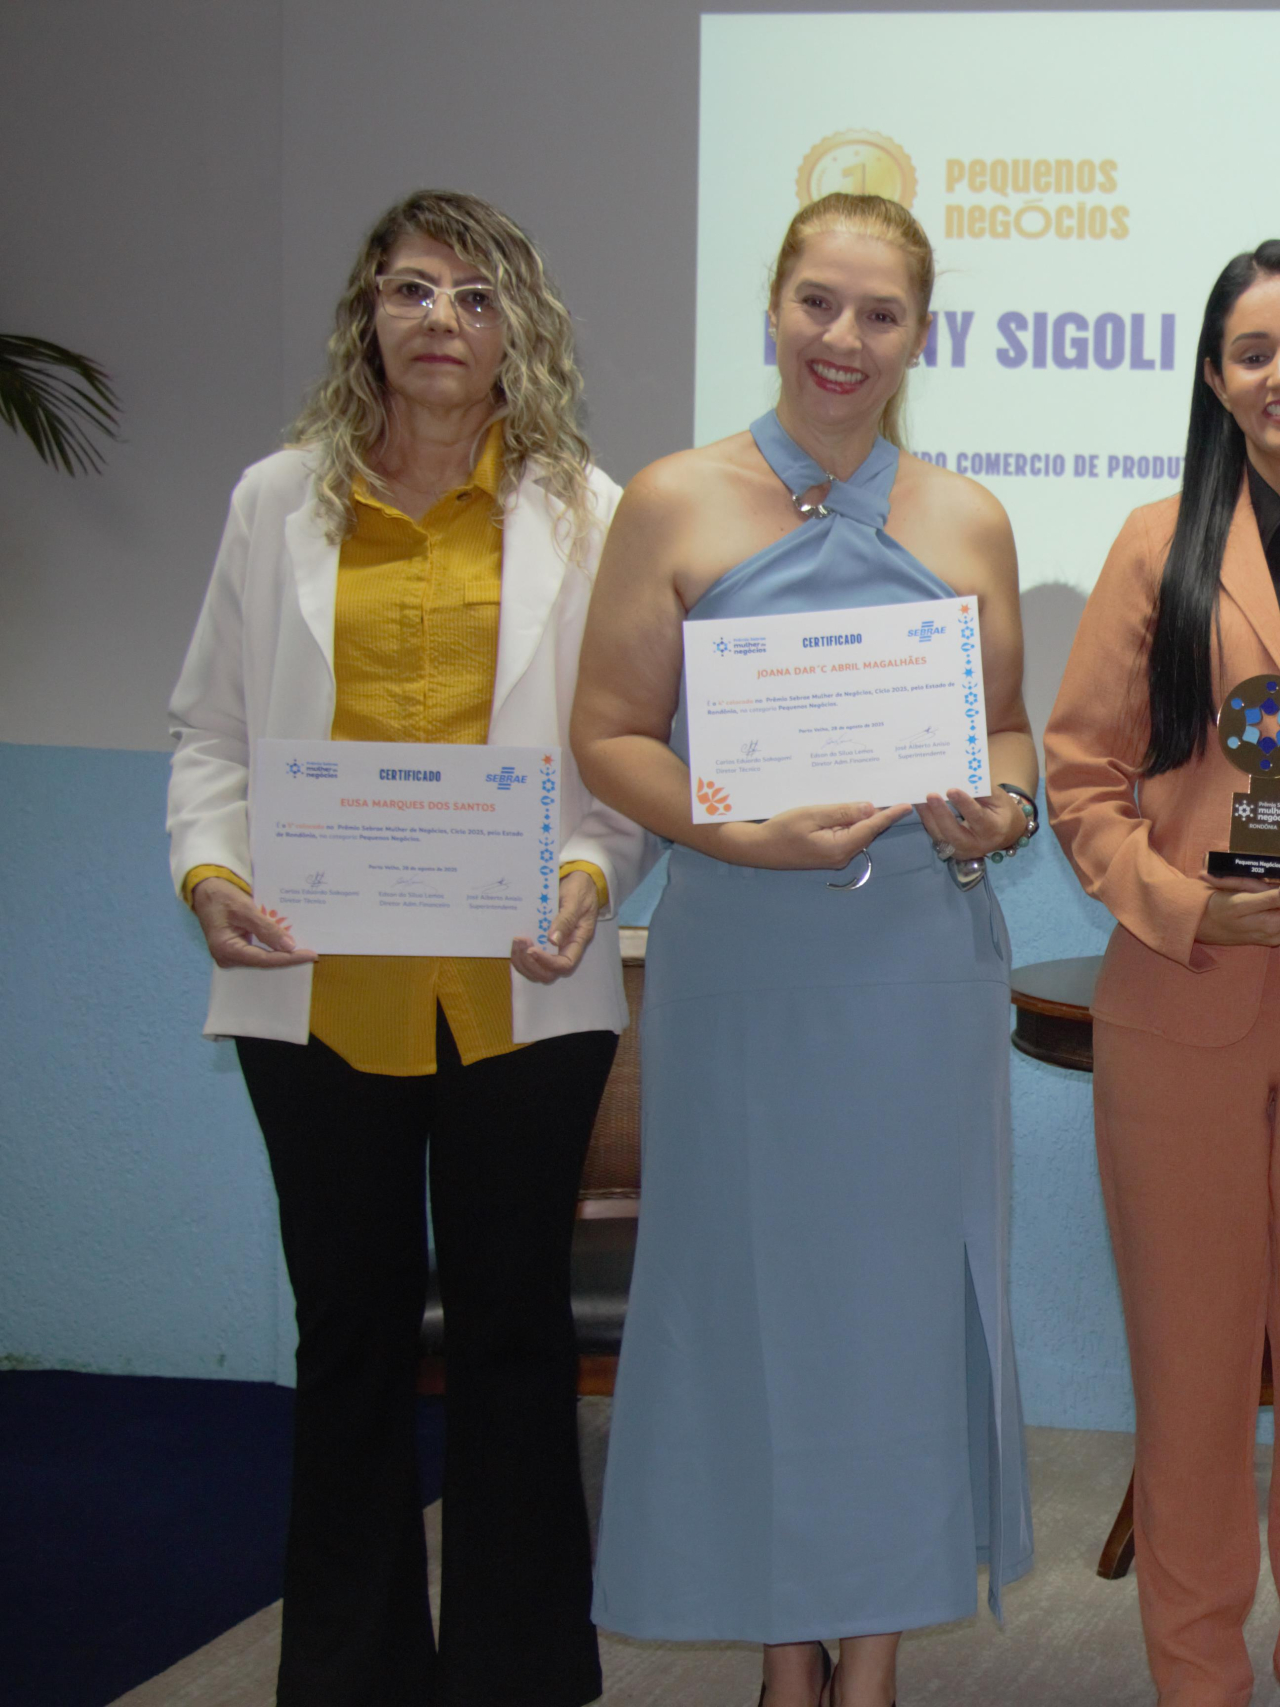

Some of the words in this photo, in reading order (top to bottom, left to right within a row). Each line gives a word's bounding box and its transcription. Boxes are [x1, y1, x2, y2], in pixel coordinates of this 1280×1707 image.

[996, 311, 1176, 370] SIGOLI
[956, 452, 1066, 477] COMERCIO
[1074, 454, 1099, 478] DE
[1108, 455, 1185, 480] PRODU
[908, 626, 946, 637] SEBRAE
[802, 634, 862, 648] CERTIFICADO
[734, 648, 766, 656] negócios
[757, 668, 791, 680] JOANA
[831, 662, 860, 672] ABRIL
[863, 656, 927, 670] MAGALHÃES
[778, 704, 807, 712] Pequenos
[898, 750, 946, 759] Superintendente
[379, 769, 441, 782] CERTIFICADO
[486, 774, 528, 784] SEBRAE
[372, 799, 425, 811] MARQUES
[428, 802, 450, 810] DOS
[453, 802, 496, 812] SANTOS
